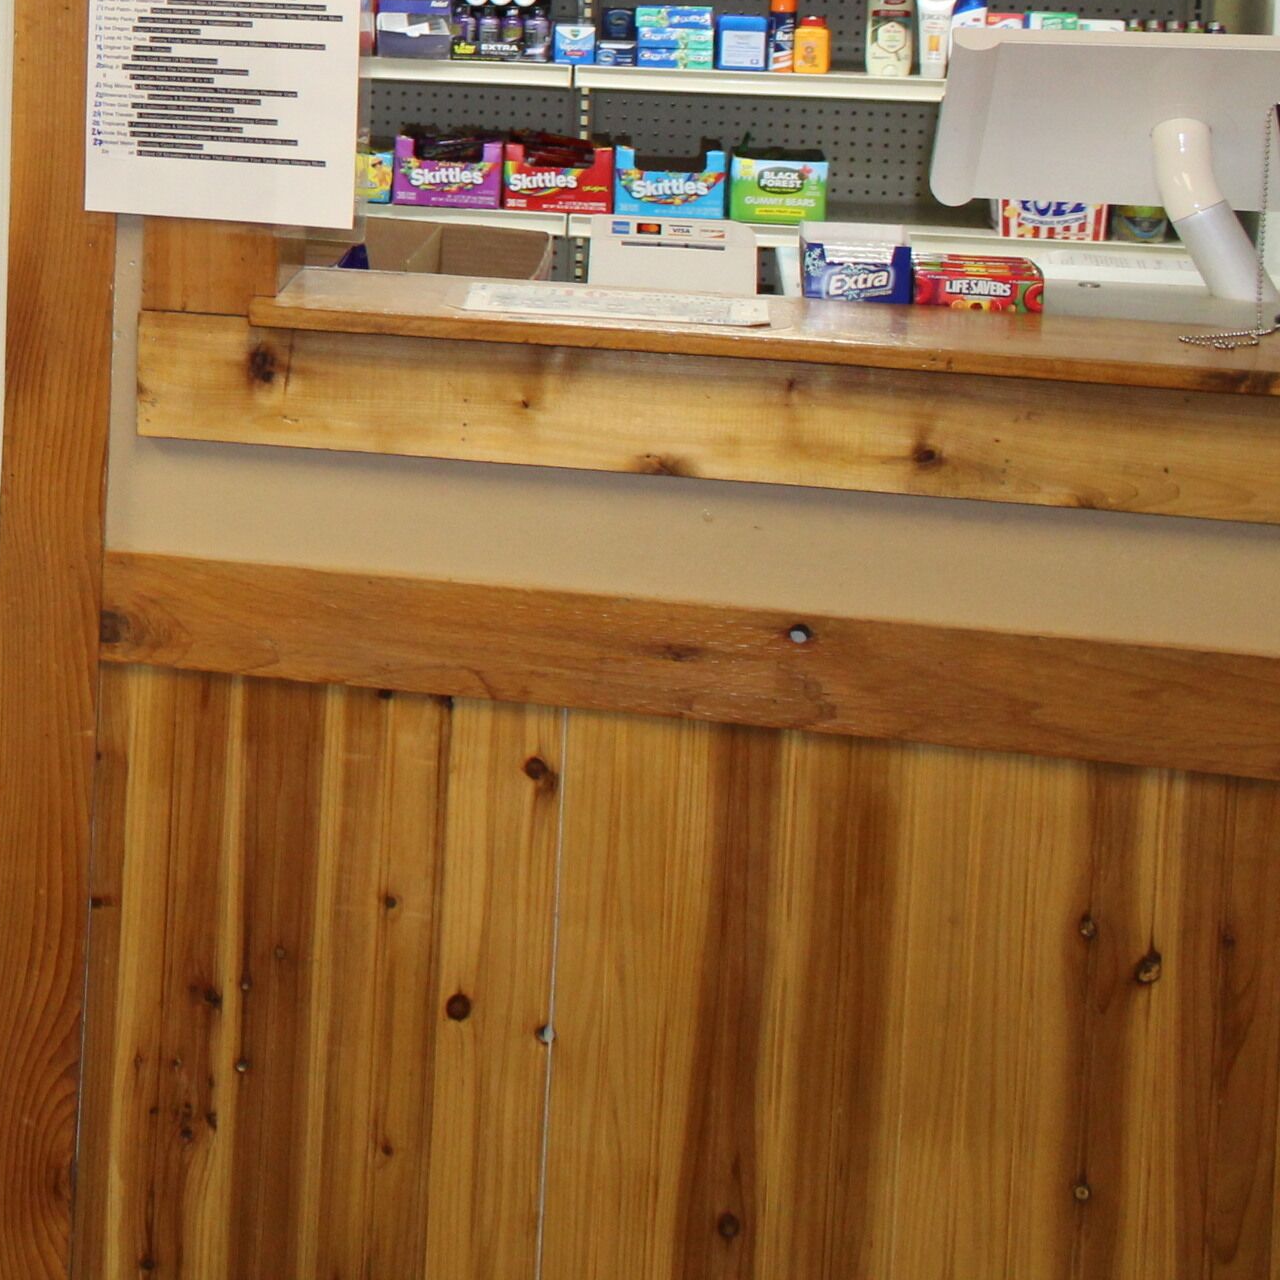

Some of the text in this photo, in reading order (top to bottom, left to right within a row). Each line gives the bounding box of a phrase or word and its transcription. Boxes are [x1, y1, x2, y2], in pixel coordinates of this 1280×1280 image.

[481, 43, 519, 51] EXTRA
[410, 167, 484, 186] Skittles
[509, 172, 578, 191] Skittles
[760, 179, 802, 188] FOREST
[763, 171, 799, 179] BLACK
[631, 178, 709, 198] Skittles
[744, 196, 816, 207] GUMMY BEARS
[829, 271, 888, 295] Extra
[945, 280, 1011, 297] LIFE SAVERS
